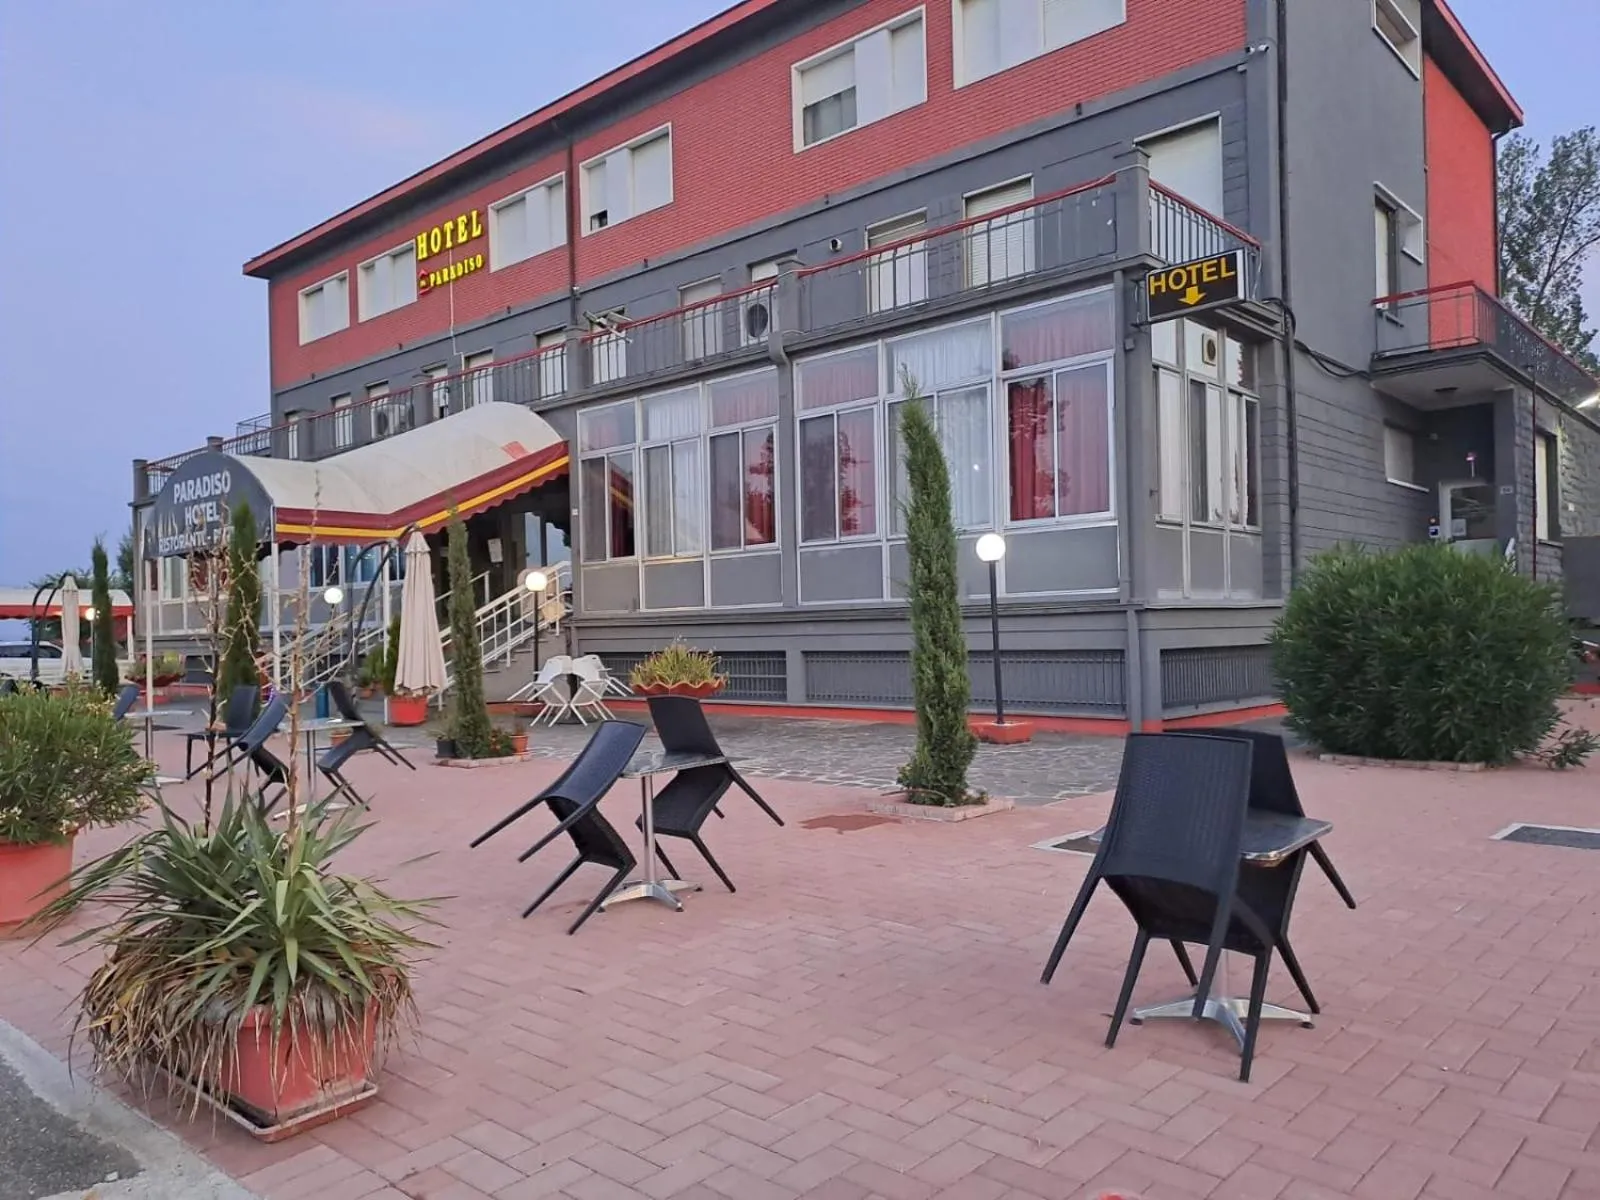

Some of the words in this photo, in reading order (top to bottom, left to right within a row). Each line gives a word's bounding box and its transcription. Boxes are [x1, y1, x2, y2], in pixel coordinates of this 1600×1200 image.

[416, 210, 482, 260] HOTEL
[429, 254, 482, 287] PARADISO
[1149, 257, 1236, 295] HOTEL
[173, 470, 231, 504] PARADISO
[184, 501, 220, 527] HOTEL
